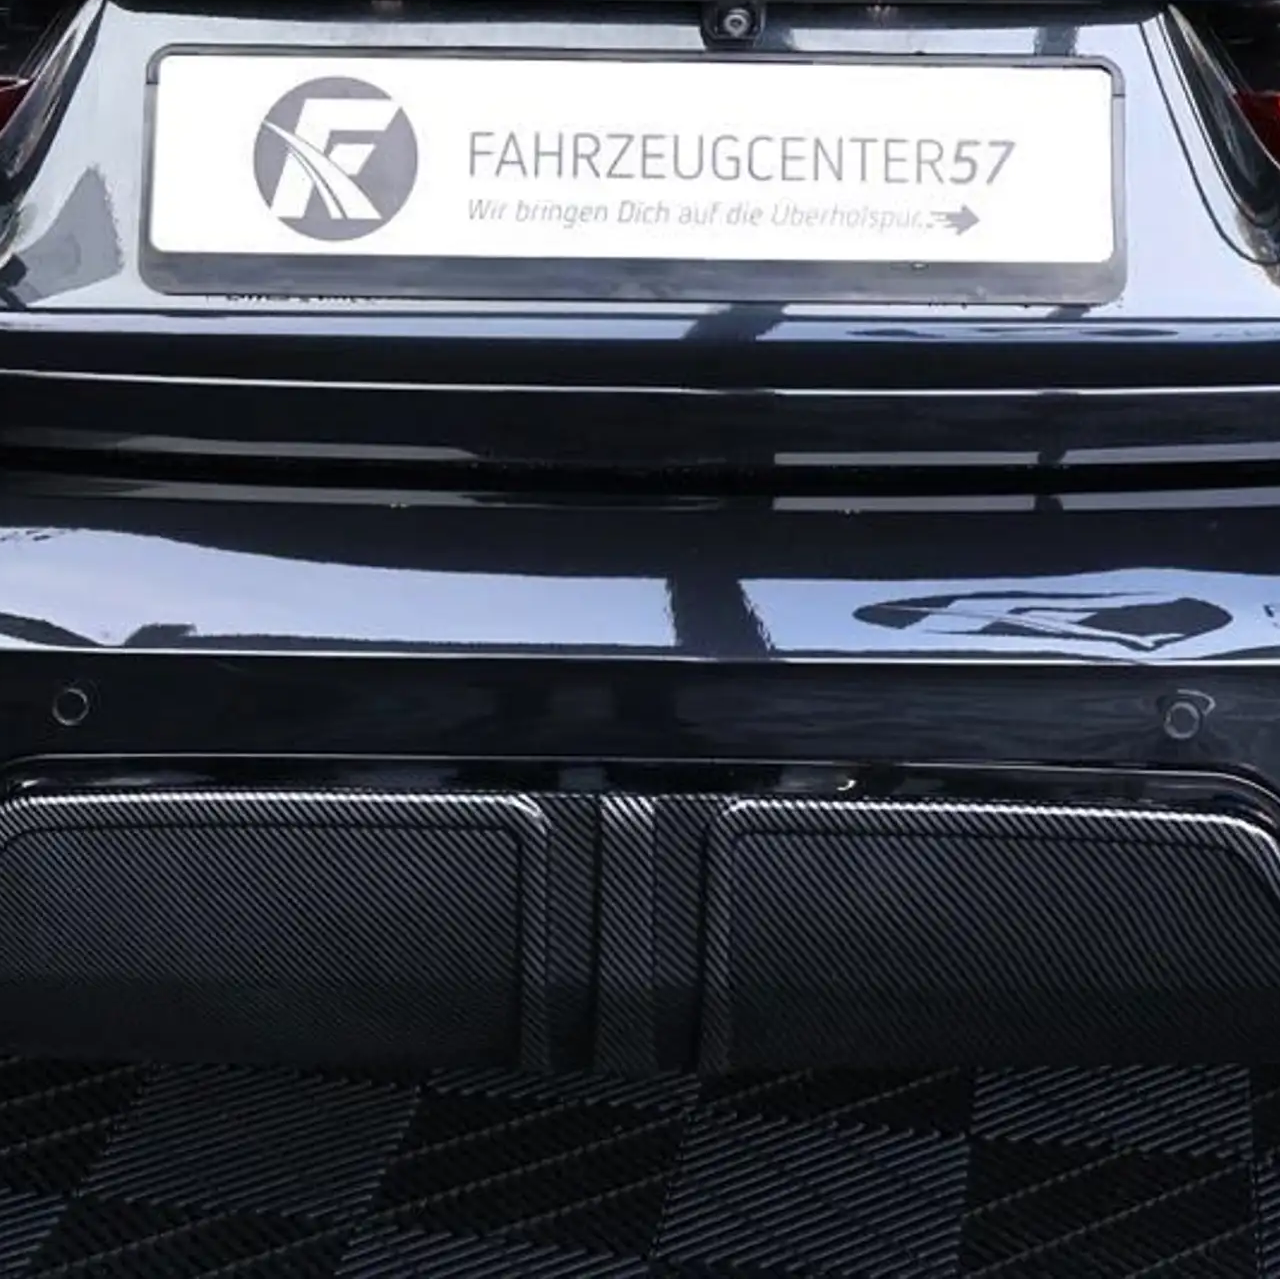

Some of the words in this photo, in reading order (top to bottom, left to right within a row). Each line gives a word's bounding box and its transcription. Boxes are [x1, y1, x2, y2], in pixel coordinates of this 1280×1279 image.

[469, 131, 1016, 185] FAHRZEUGCENTER57
[469, 198, 506, 221] Wir
[515, 199, 609, 229] bringen
[617, 200, 670, 225] Dich
[678, 201, 720, 226] auf
[726, 201, 764, 227] die
